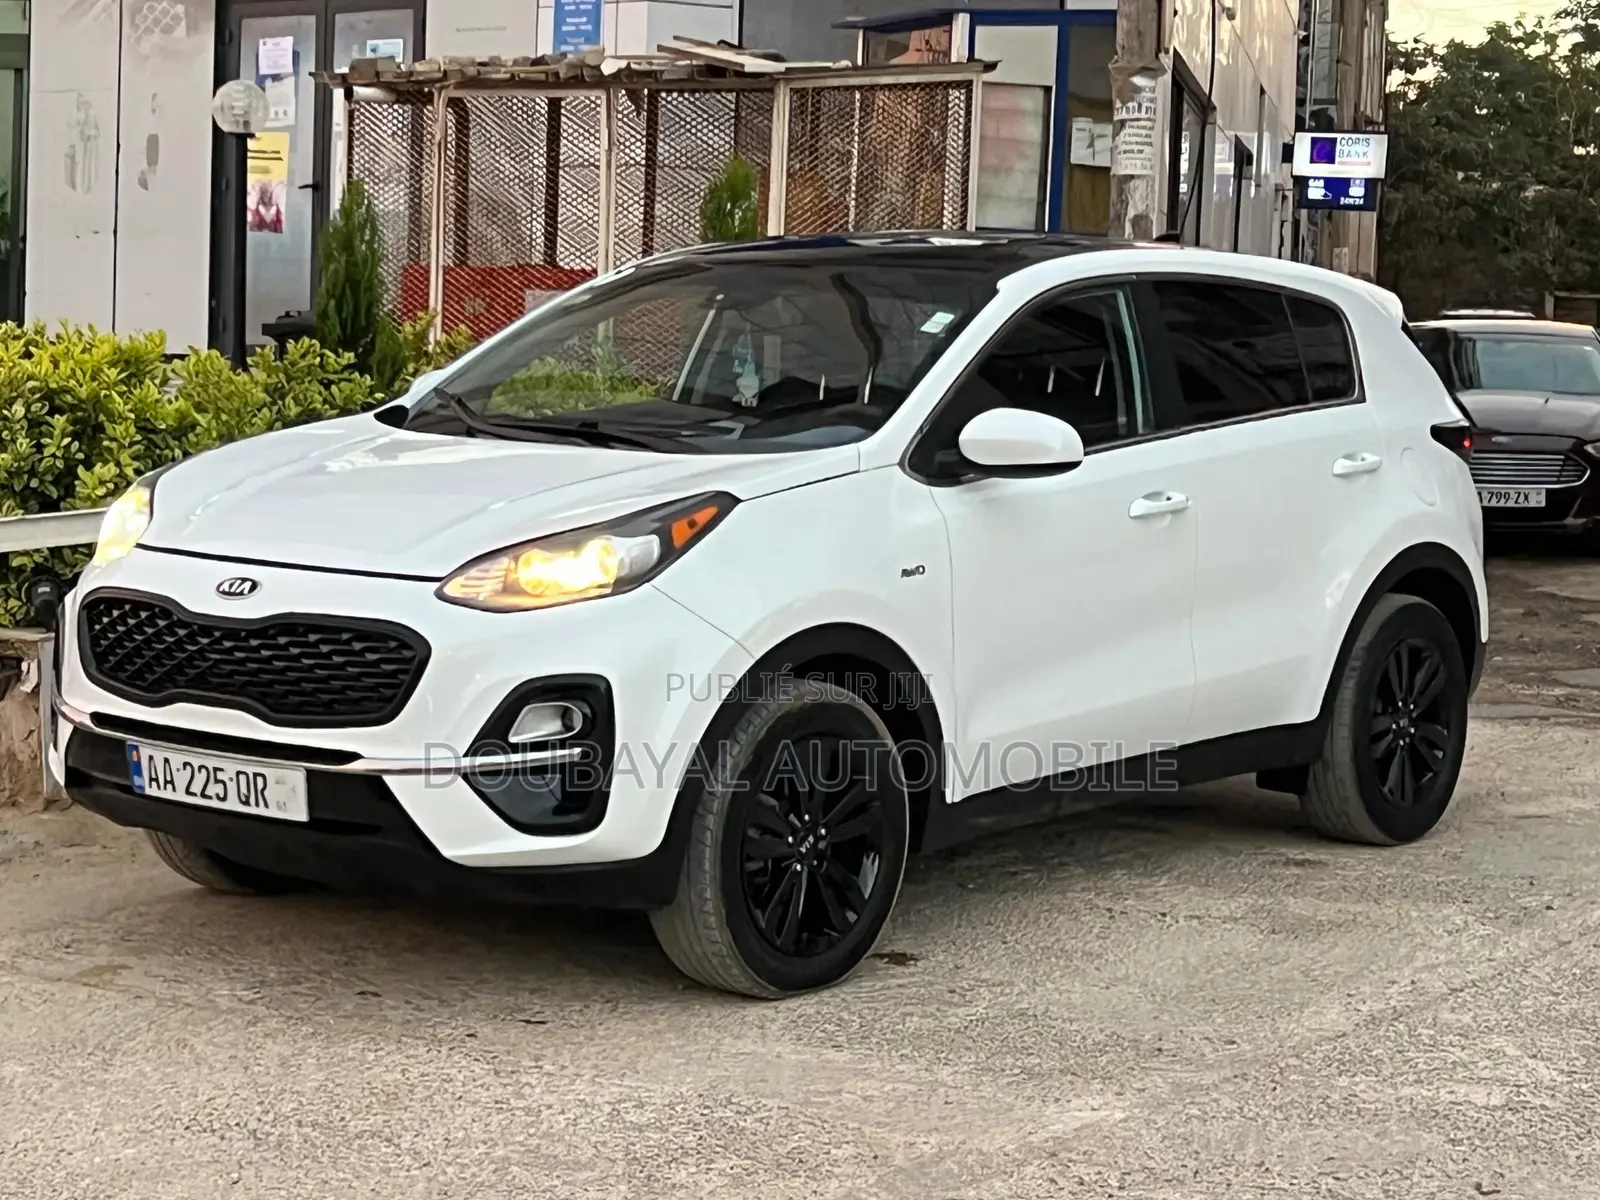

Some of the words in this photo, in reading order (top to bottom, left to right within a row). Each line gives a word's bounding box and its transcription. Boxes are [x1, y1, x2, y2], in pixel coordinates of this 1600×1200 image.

[1339, 137, 1370, 147] CORIS
[1338, 149, 1369, 159] BANK
[218, 576, 253, 595] KIA
